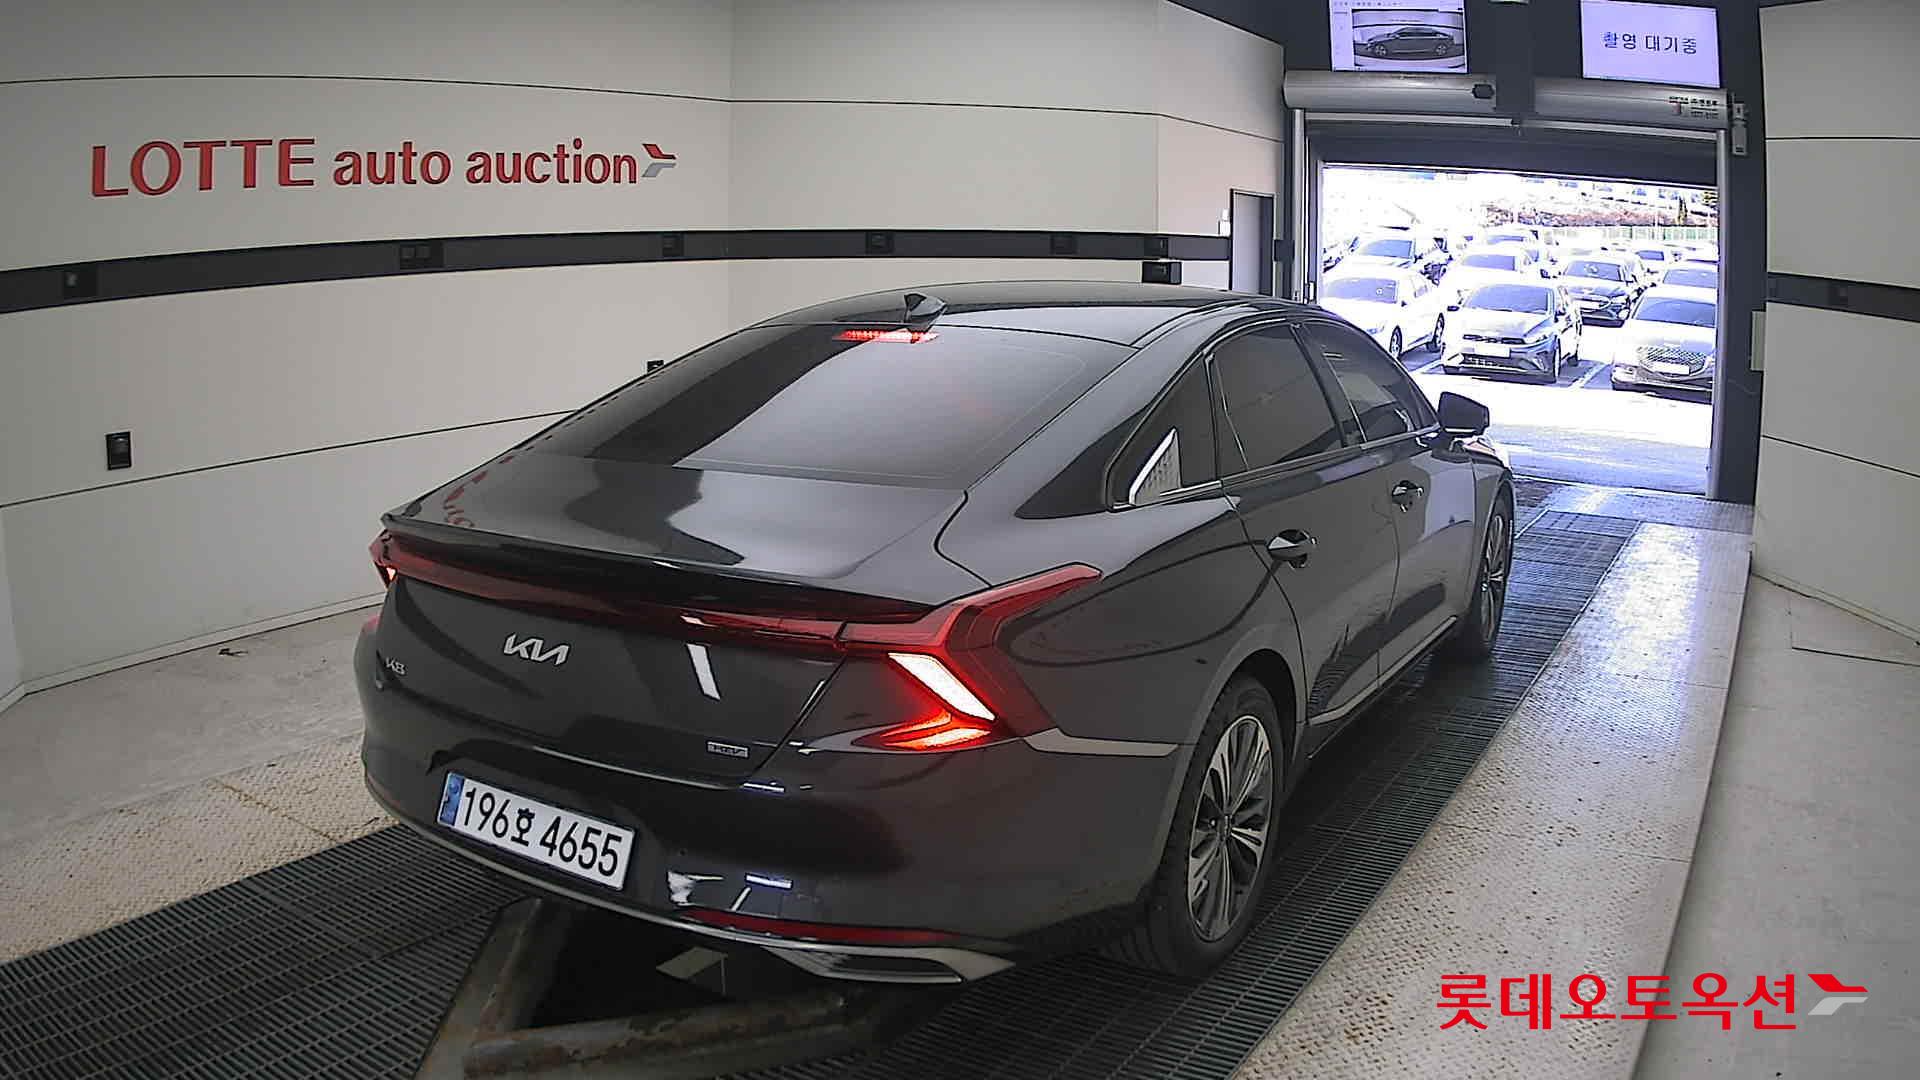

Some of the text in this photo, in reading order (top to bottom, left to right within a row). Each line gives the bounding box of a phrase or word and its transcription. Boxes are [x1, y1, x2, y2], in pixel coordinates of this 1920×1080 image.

[91, 137, 640, 197] LOTTE auto auction
[503, 632, 570, 666] KIA
[464, 787, 623, 877] 196호 4655
